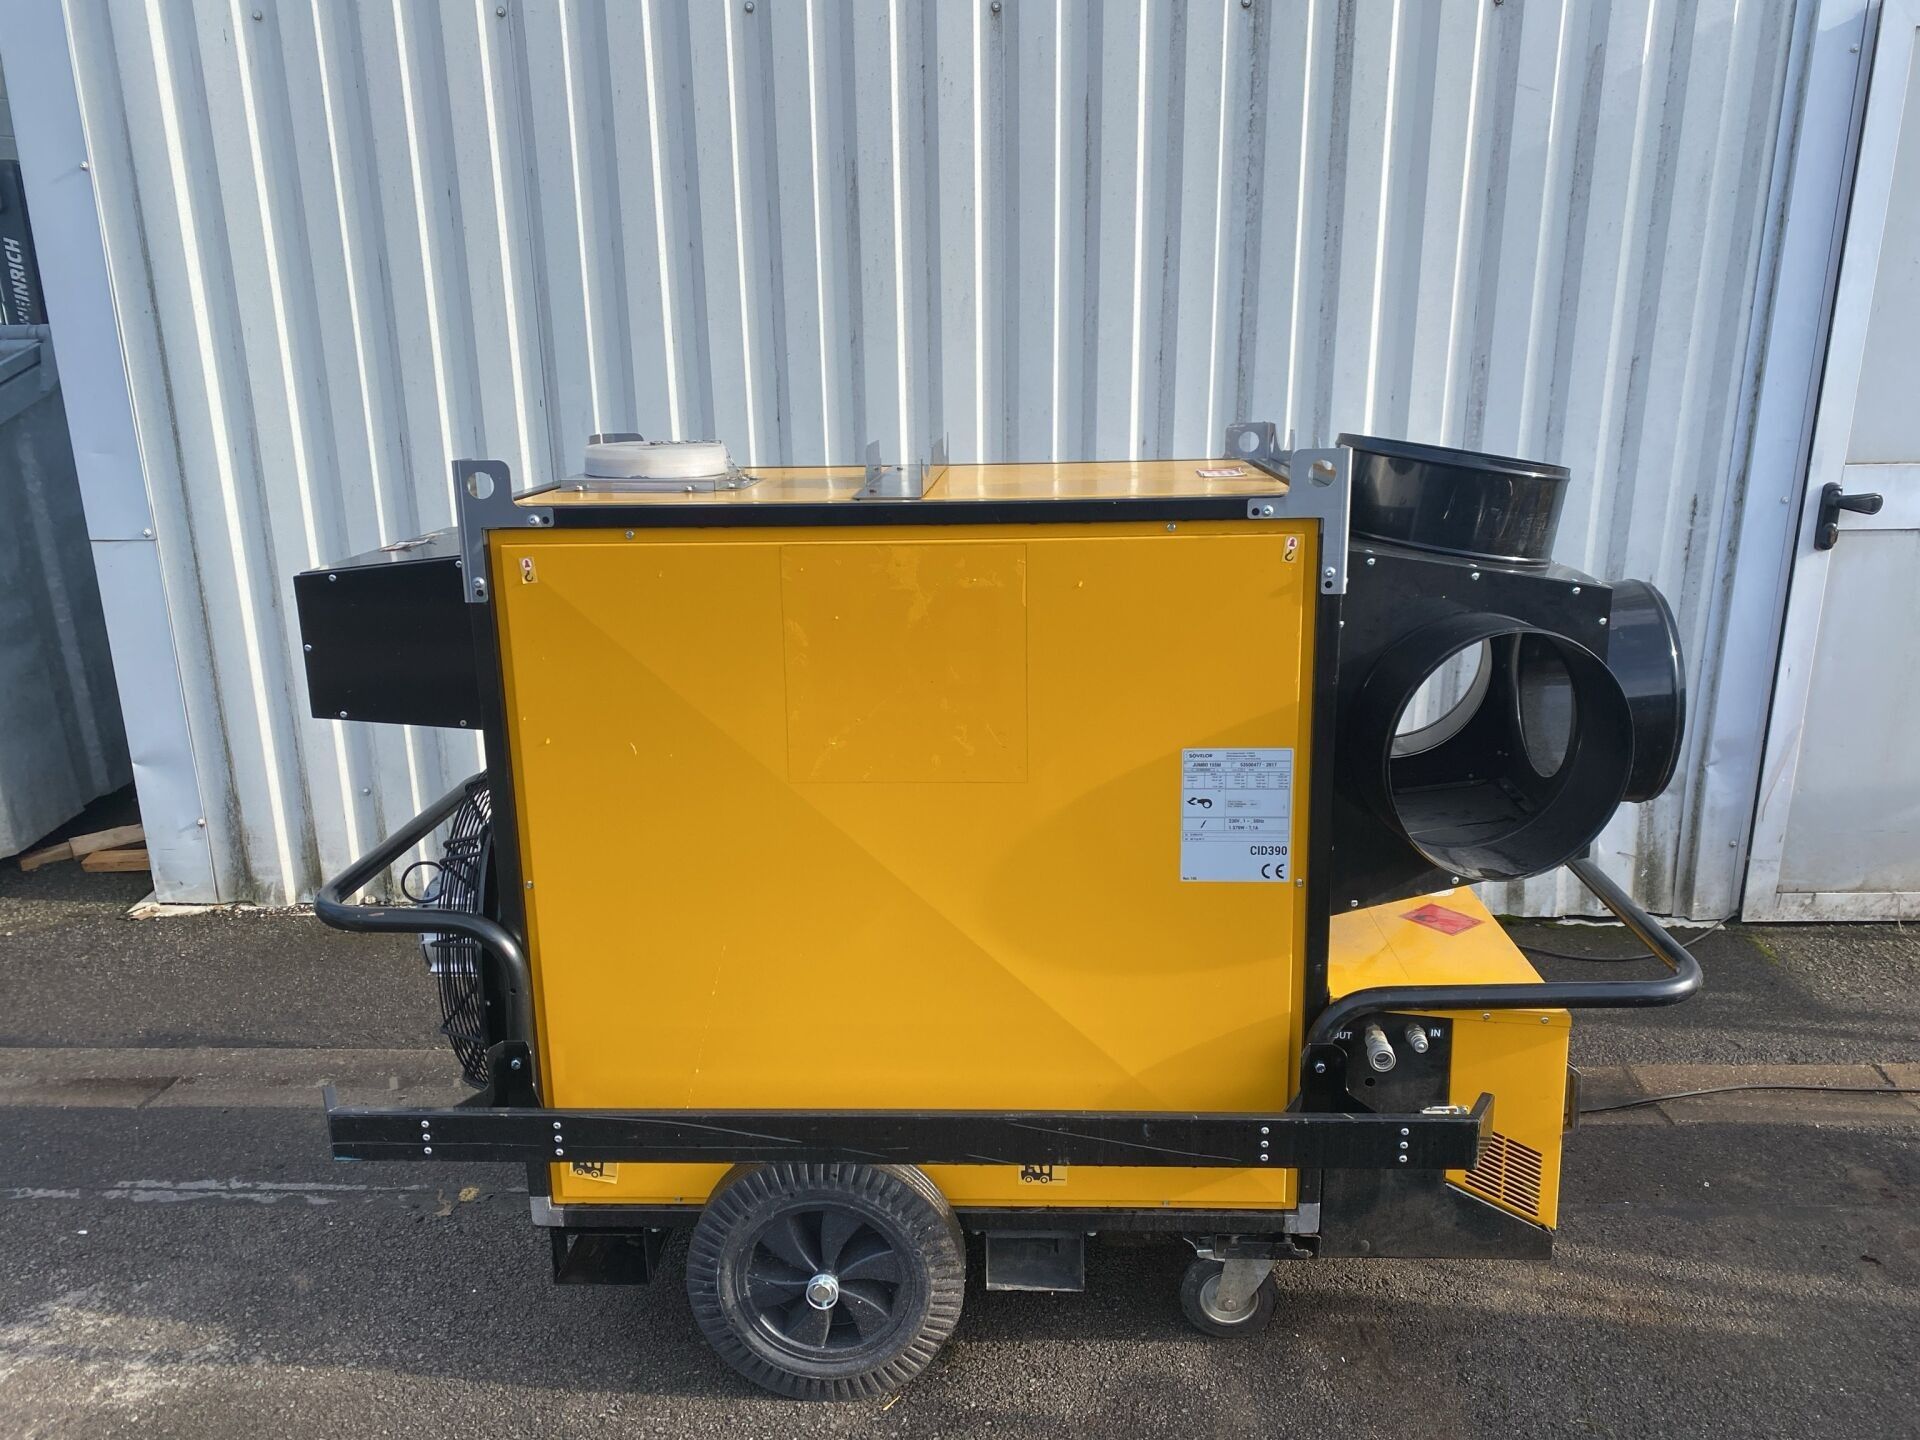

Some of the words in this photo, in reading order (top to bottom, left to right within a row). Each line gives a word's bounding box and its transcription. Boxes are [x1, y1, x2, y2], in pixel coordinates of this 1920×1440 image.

[1250, 845, 1288, 856] CID390
[1261, 863, 1285, 879] CE
[1430, 1028, 1441, 1037] IN
